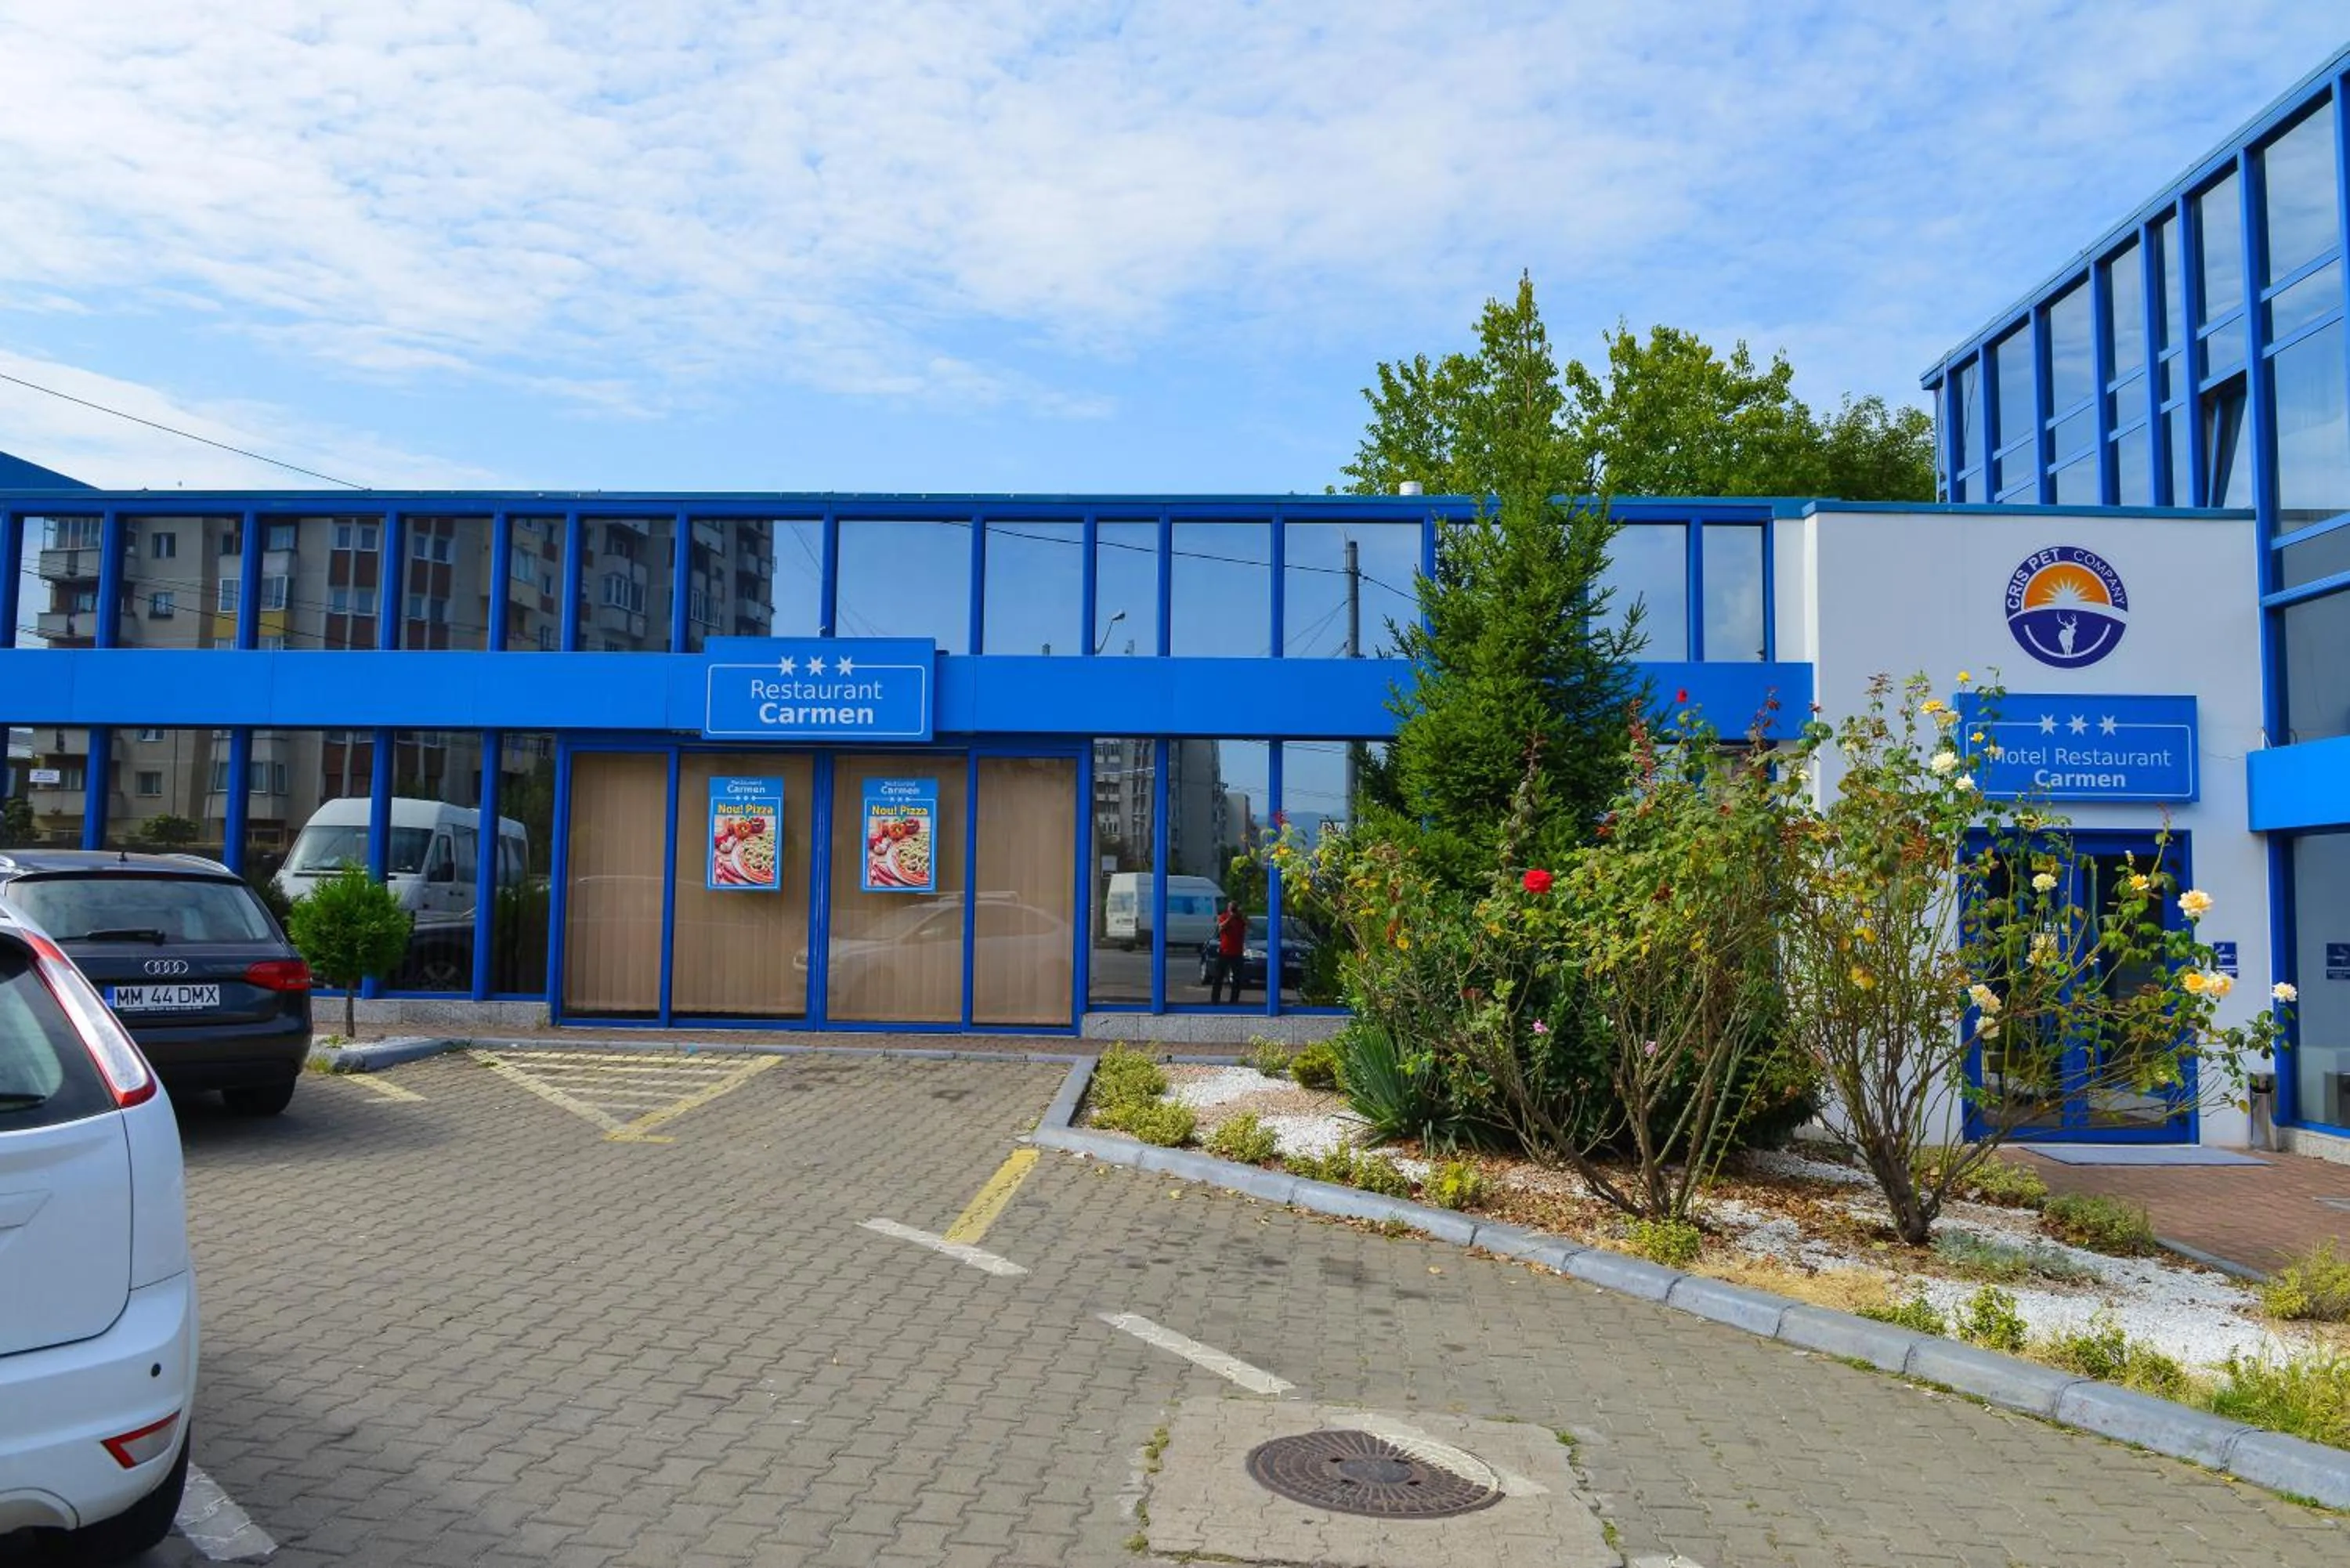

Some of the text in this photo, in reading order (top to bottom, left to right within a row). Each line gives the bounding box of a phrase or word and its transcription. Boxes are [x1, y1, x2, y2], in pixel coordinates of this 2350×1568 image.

[2007, 548, 2125, 609] CRIS PET COMPANY
[751, 679, 884, 700] Restaurant
[759, 702, 874, 724] Carmen
[2055, 748, 2172, 767] Restaurant
[2034, 768, 2126, 787] Carmen
[727, 784, 765, 793] Carmen
[880, 786, 920, 795] Carmen
[745, 804, 774, 815] Pizza
[900, 805, 928, 815] Pizza
[117, 988, 143, 1006] MM
[151, 987, 173, 1004] 44
[178, 987, 217, 1004] DMX
